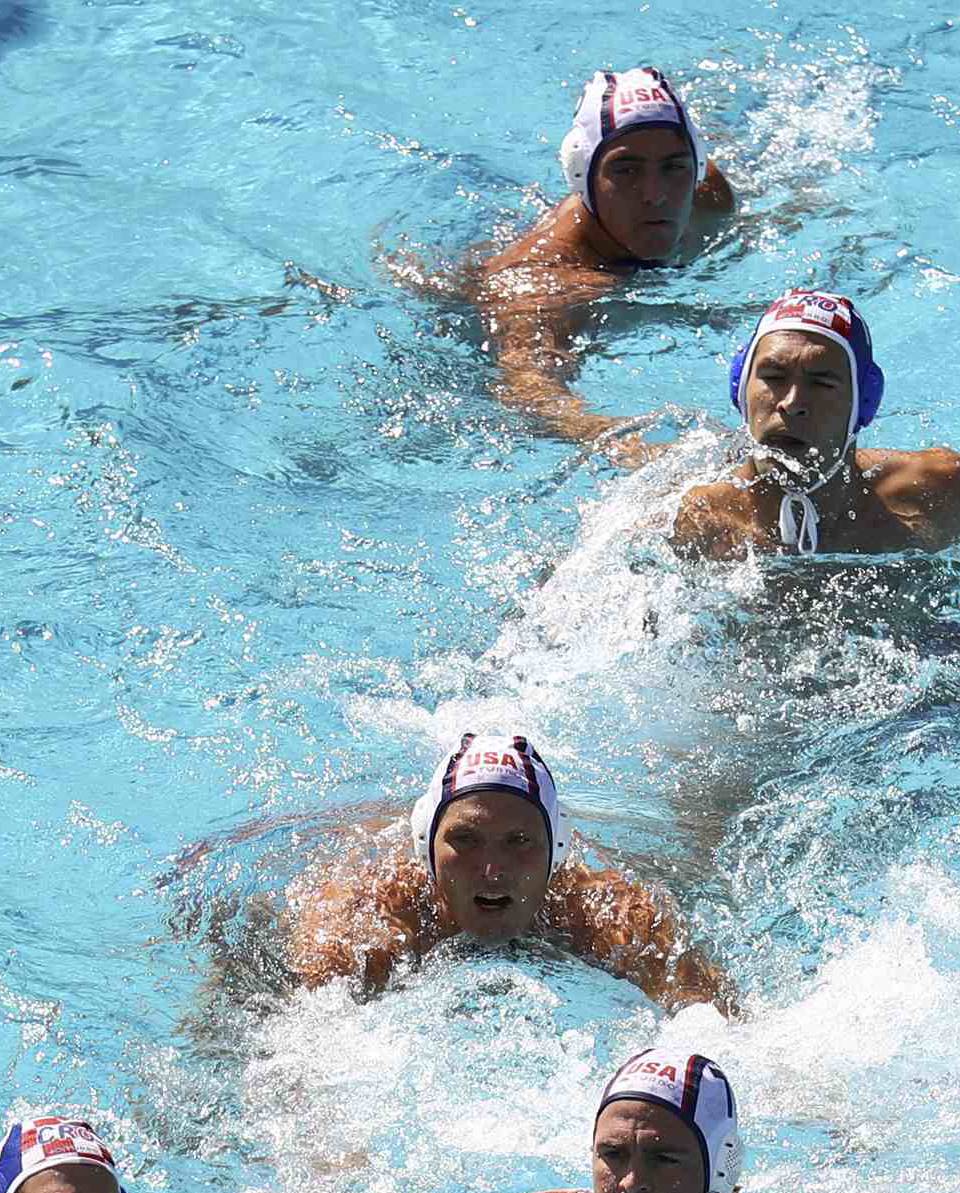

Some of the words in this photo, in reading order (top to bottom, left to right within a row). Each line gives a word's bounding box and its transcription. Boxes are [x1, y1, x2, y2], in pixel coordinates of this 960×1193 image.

[620, 88, 666, 105] USA
[467, 751, 518, 769] USA
[626, 1062, 676, 1082] USA
[38, 1125, 95, 1144] CRO
